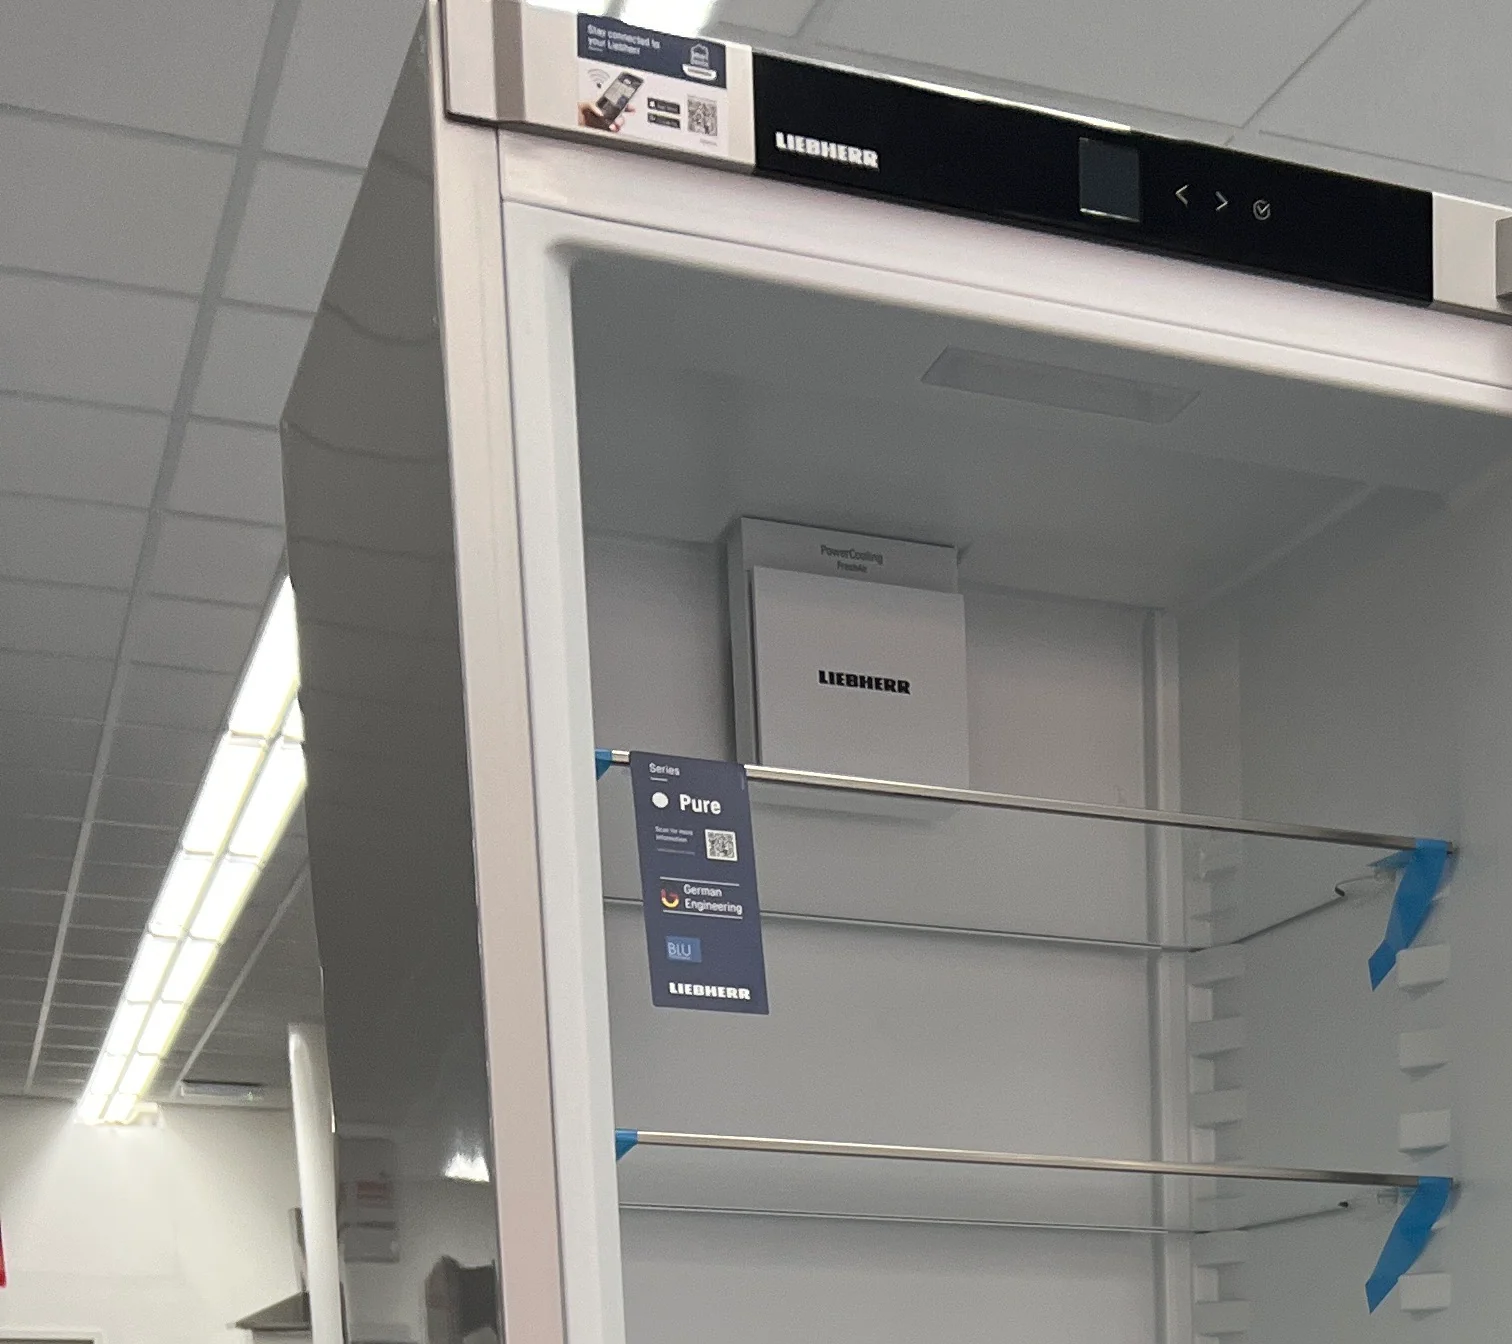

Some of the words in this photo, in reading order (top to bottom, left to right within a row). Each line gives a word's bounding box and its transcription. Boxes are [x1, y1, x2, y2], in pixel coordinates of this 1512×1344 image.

[775, 131, 879, 169] LIEBHERR
[820, 544, 883, 565] PowerCooling
[818, 669, 911, 695] LIEBHERR
[649, 762, 680, 776] Series
[680, 793, 721, 815] Pure
[683, 884, 722, 897] German
[684, 898, 743, 916] Engineering
[669, 982, 751, 1000] LIEBHERR
